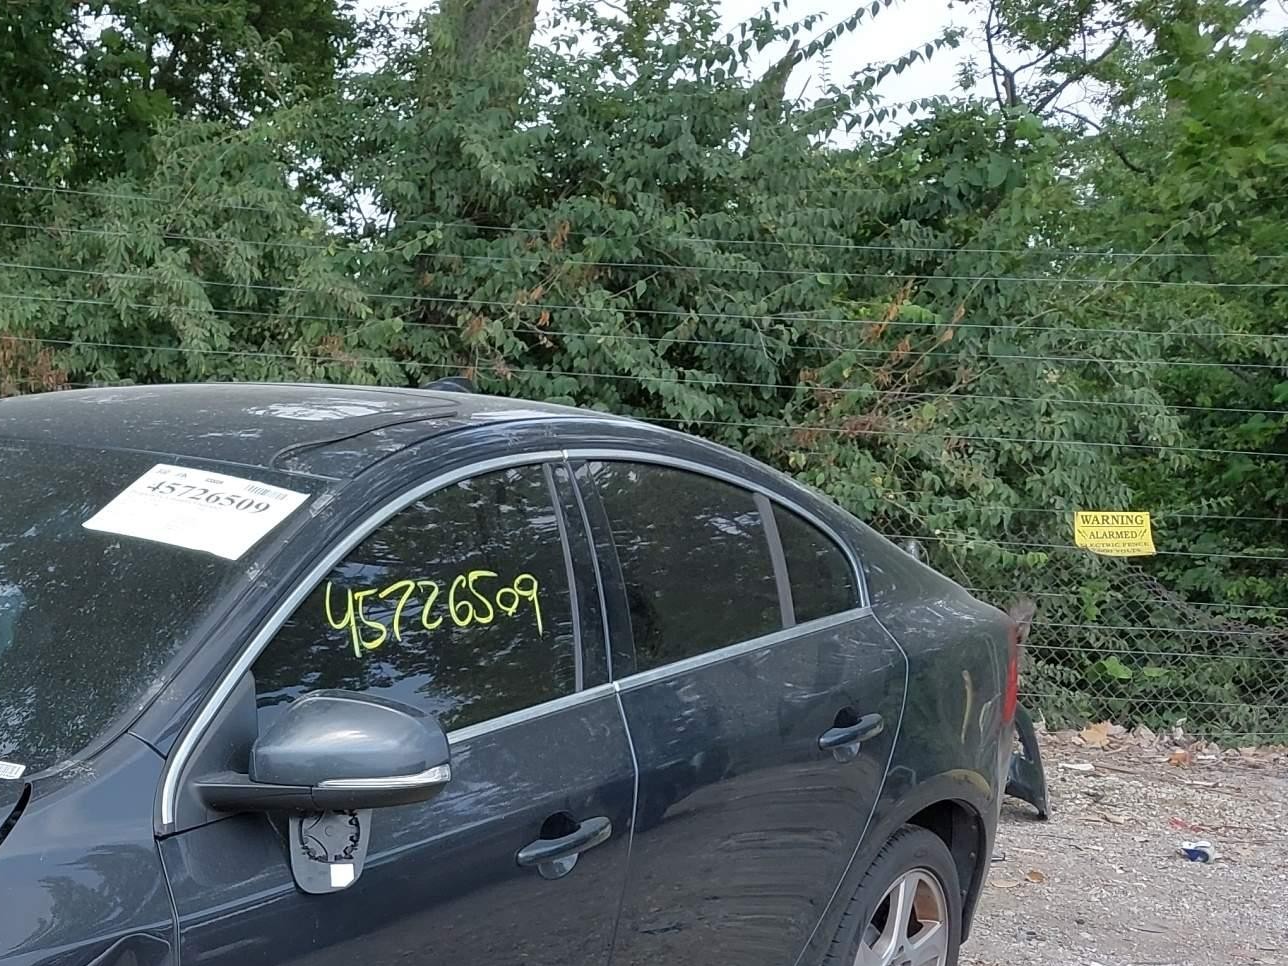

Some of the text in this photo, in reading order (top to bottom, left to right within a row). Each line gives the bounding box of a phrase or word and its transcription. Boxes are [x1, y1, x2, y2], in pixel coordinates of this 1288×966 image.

[147, 481, 271, 514] 45726509
[1080, 514, 1144, 525] WARNING
[1088, 530, 1138, 540] ALARMED
[325, 570, 543, 658] 45726509
